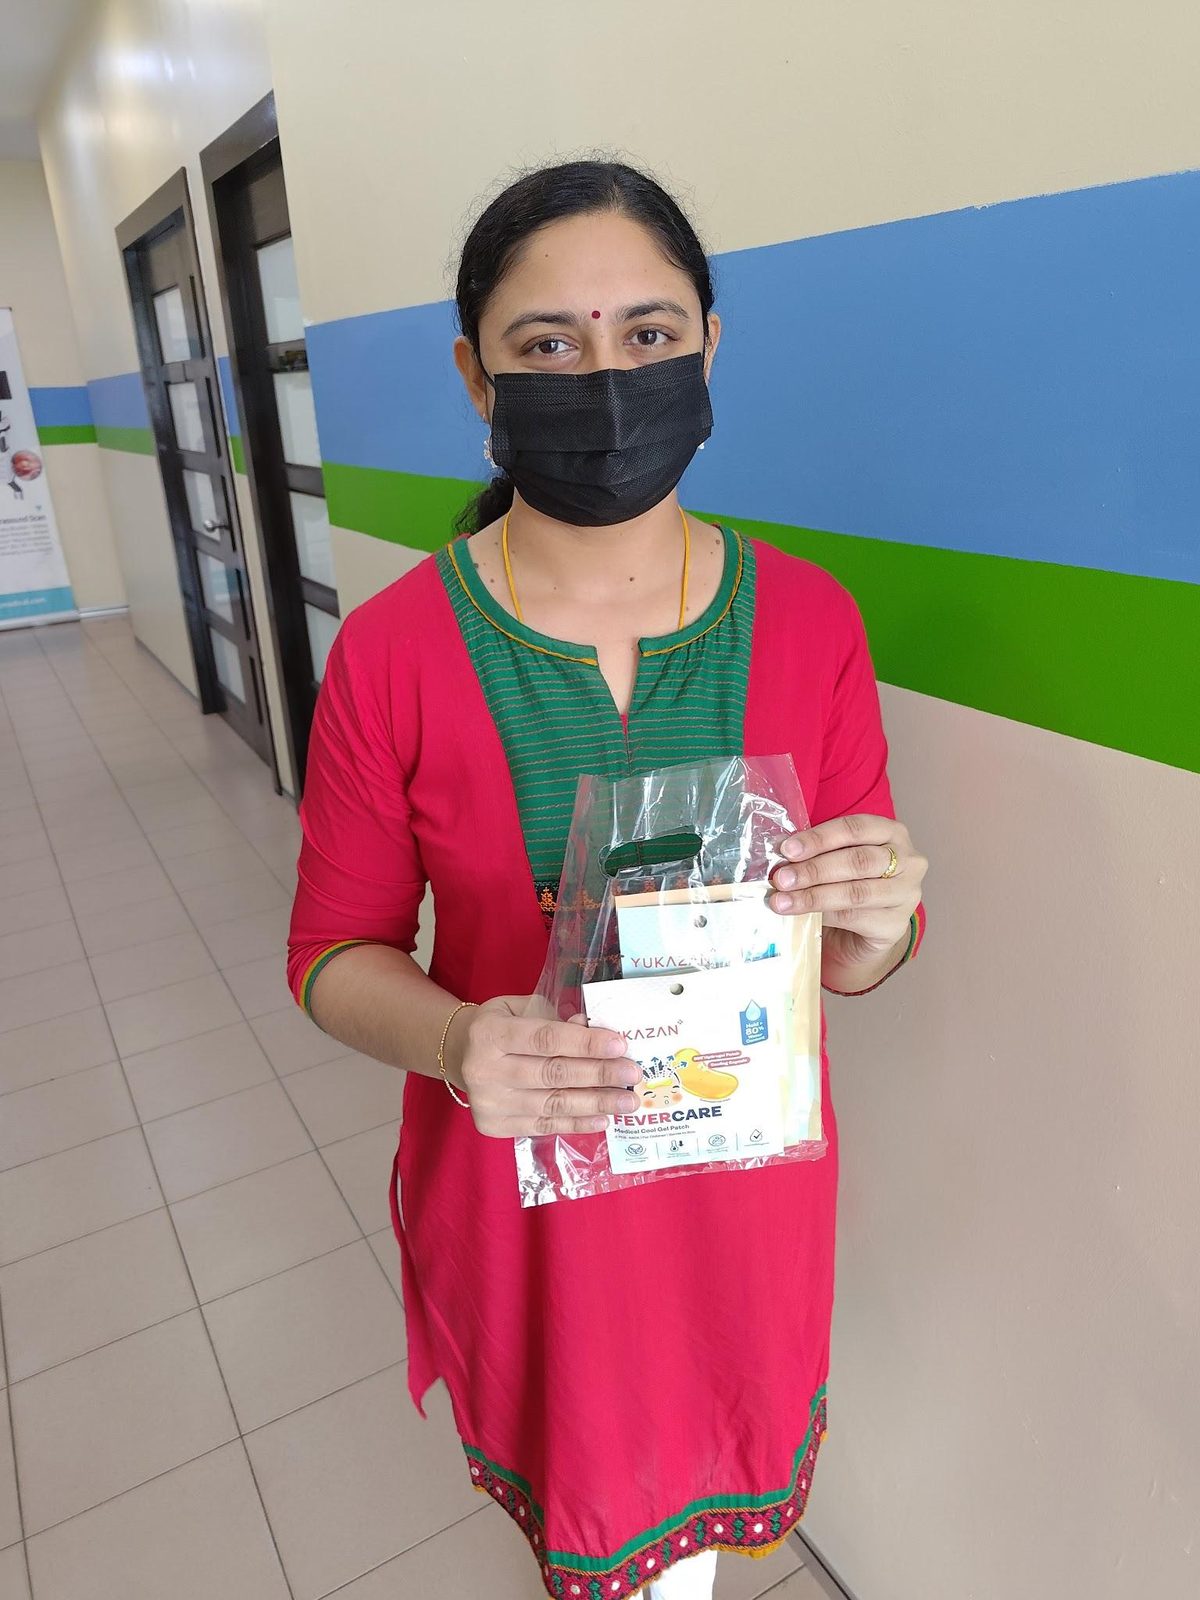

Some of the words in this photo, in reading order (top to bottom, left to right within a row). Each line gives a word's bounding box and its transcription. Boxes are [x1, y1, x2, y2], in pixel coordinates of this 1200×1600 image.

[631, 955, 704, 968] YUKAZ
[617, 1025, 679, 1040] KAZAN
[745, 1025, 765, 1036] 80%
[670, 1124, 690, 1132] Patch
